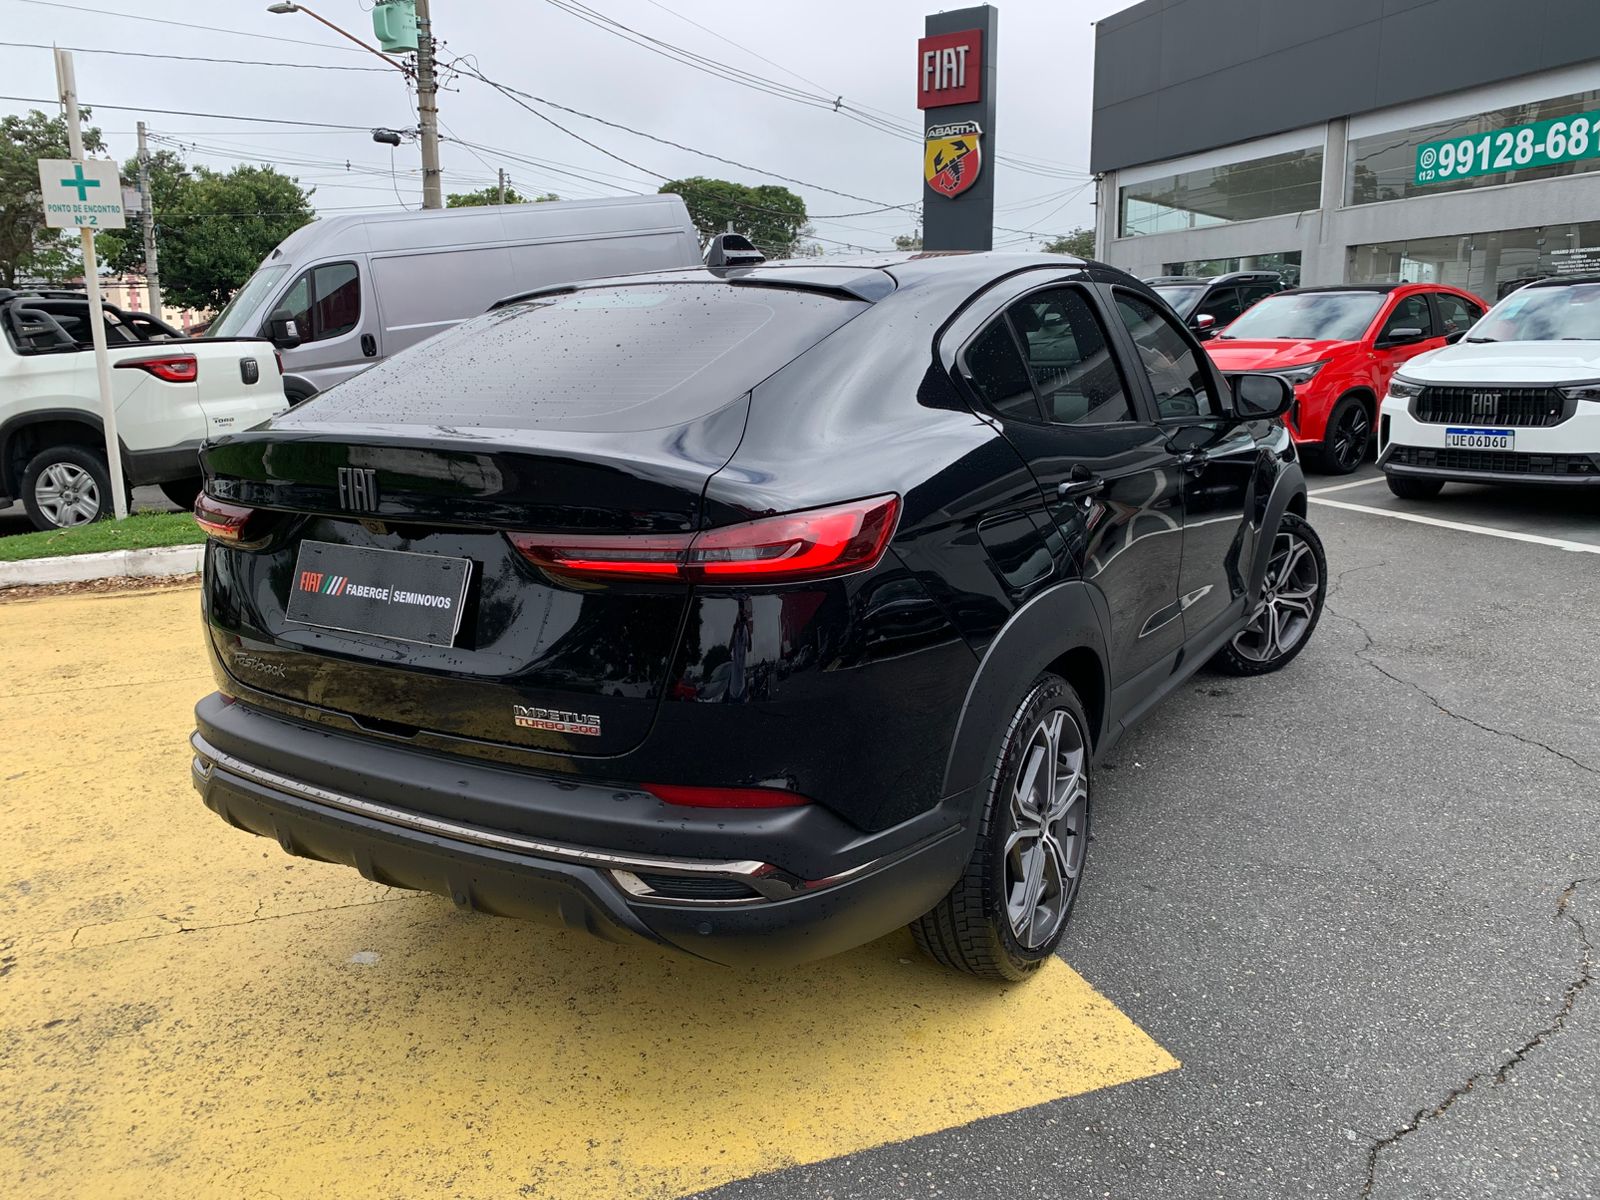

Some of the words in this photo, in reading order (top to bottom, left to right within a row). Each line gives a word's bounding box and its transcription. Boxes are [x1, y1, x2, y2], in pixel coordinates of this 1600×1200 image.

[923, 45, 969, 91] FIAT
[928, 126, 975, 138] ABARTH
[1418, 170, 1435, 182] (12)
[48, 204, 71, 213] PONTO
[73, 204, 82, 213] DE
[83, 205, 121, 213] ENCONTRO
[89, 215, 98, 225] 2
[1471, 393, 1502, 415] FIAT
[337, 467, 376, 512] FIAT
[299, 571, 323, 593] FIAT
[346, 583, 389, 601] FABERGE
[393, 590, 451, 609] SEMINOVOS
[234, 652, 287, 678] Fastback
[513, 704, 601, 726] IMPETUS
[515, 717, 566, 731] TURBO
[570, 724, 599, 735] 200
